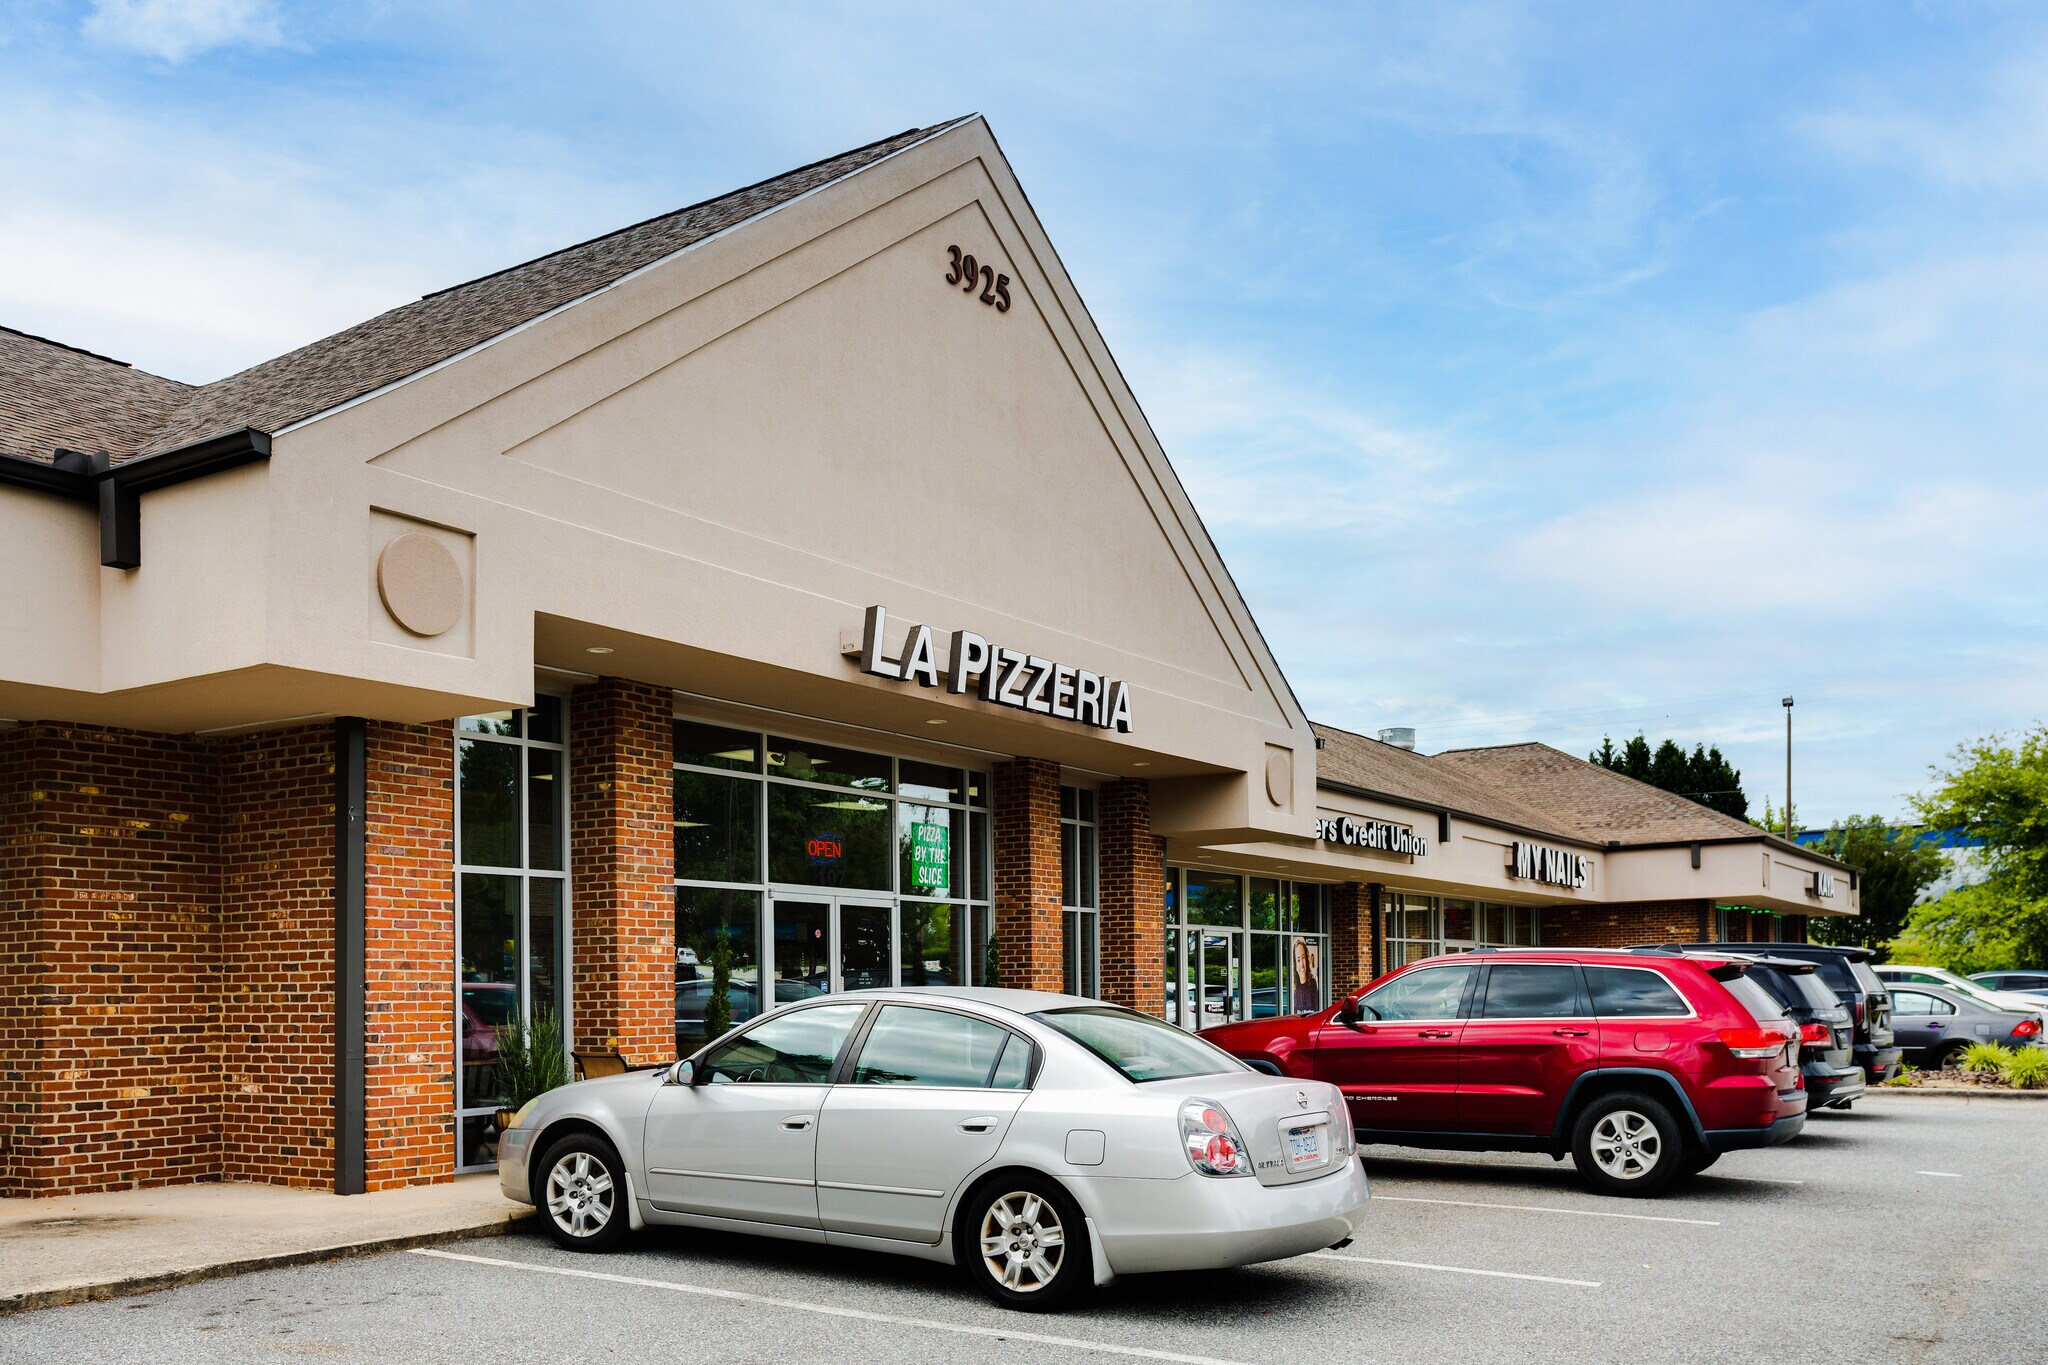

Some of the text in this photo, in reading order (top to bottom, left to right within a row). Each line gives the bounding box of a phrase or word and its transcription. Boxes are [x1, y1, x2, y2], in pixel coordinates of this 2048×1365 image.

[945, 244, 1011, 312] 3925
[863, 604, 1133, 733] LA PIZZERIA
[807, 840, 842, 858] OPEN
[917, 825, 941, 843] PIZZA
[1341, 816, 1387, 850] Credit
[1390, 825, 1428, 856] Union
[914, 845, 945, 864] BY THE
[1516, 842, 1587, 889] MY NAILS
[918, 865, 942, 885] SLICE
